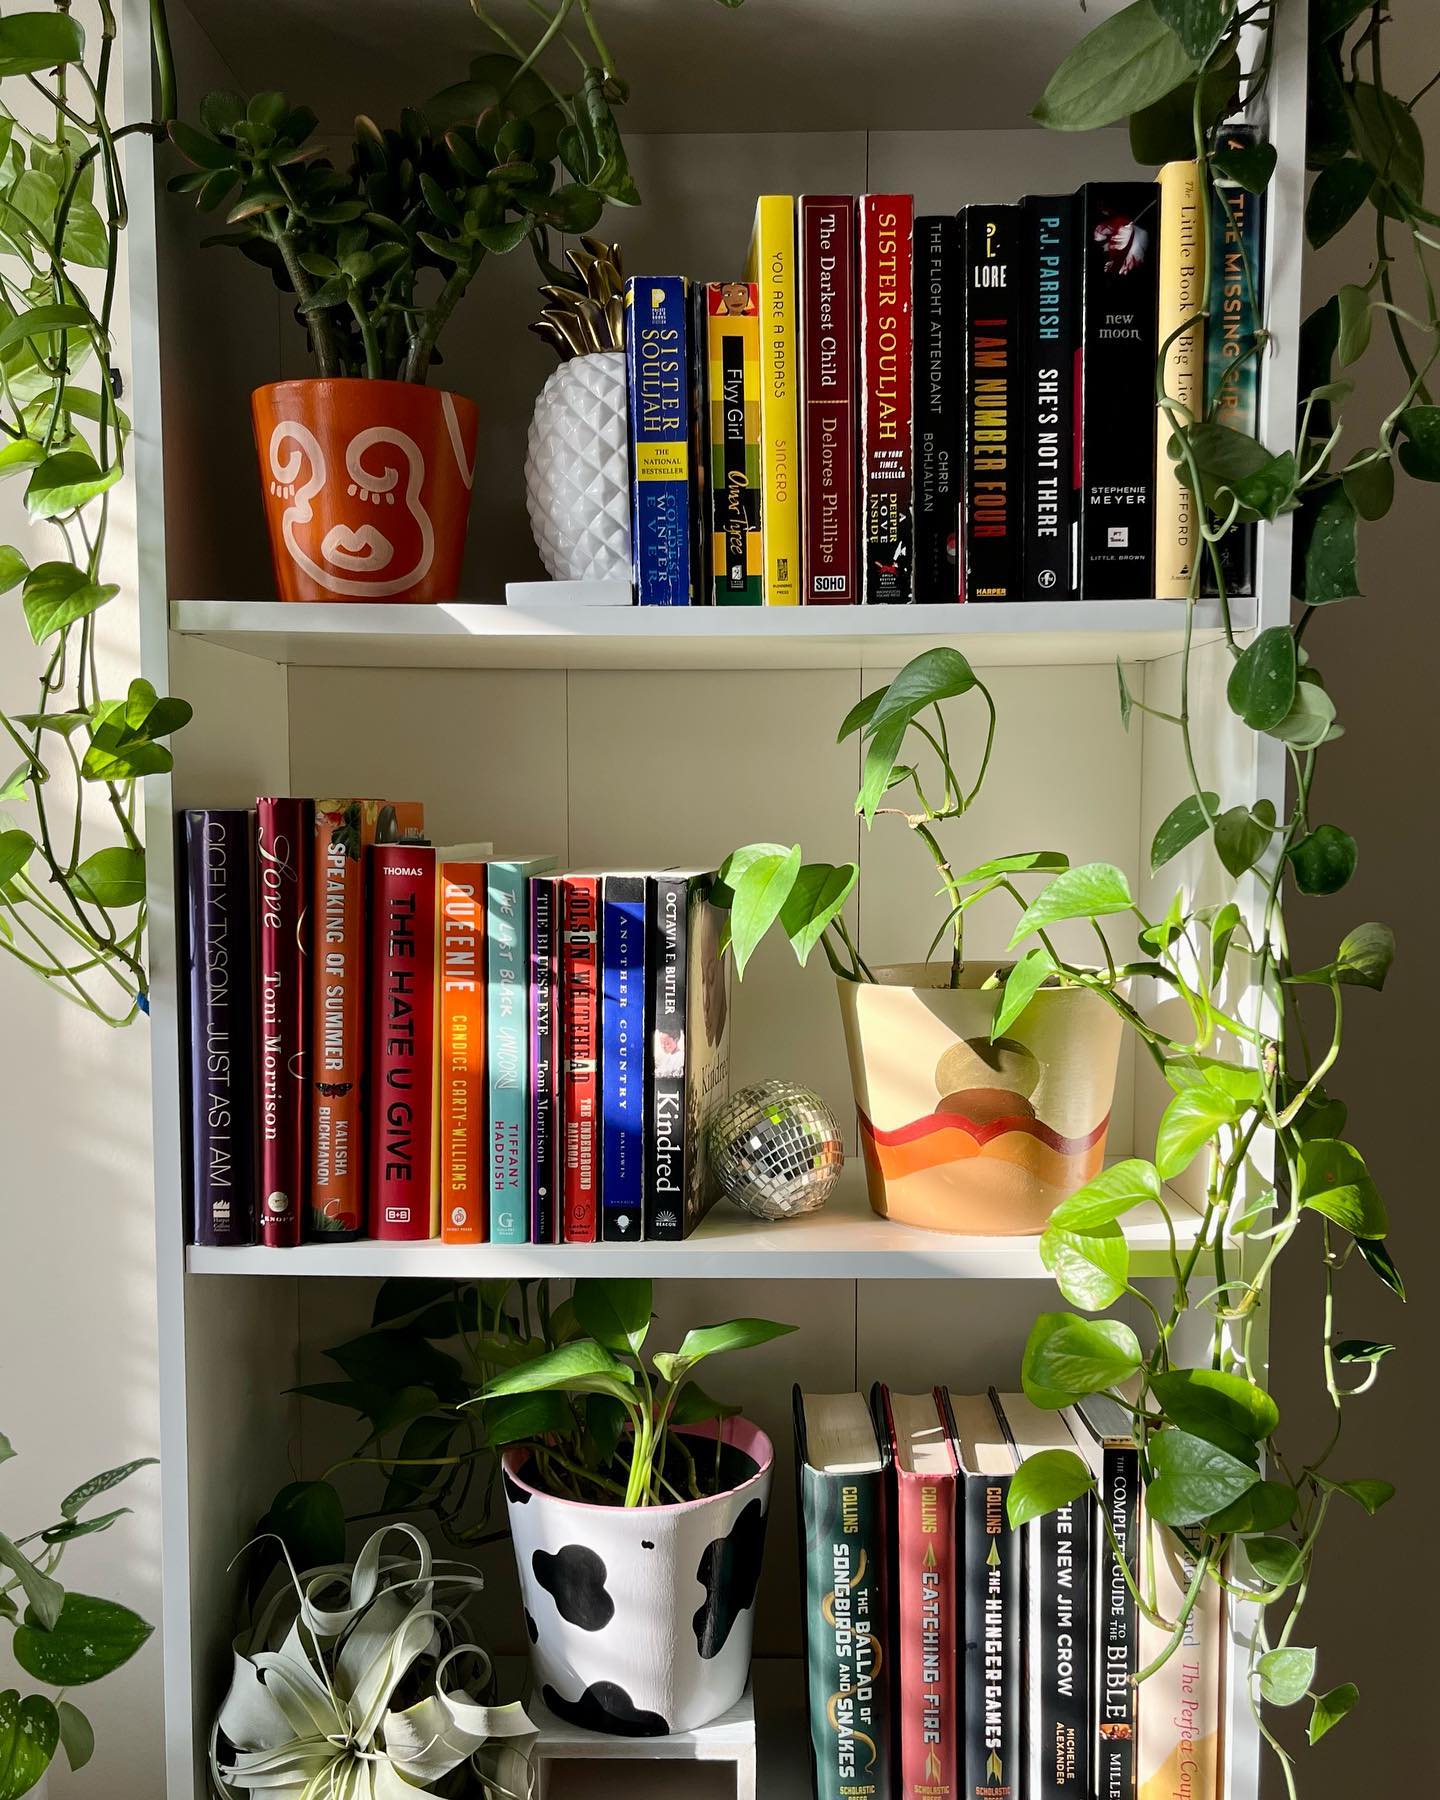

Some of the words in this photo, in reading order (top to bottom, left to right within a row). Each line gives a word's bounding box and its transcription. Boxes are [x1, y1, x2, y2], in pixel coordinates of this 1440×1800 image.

[1184, 181, 1194, 199] The
[819, 214, 835, 251] The
[930, 223, 942, 255] THE
[1039, 218, 1060, 251] P.J.
[1180, 206, 1196, 258] Little
[1223, 193, 1246, 245] THE
[771, 252, 785, 286] YOU
[878, 213, 897, 307] SISTER
[974, 265, 1007, 288] LORE
[772, 291, 785, 318] ARE
[820, 256, 836, 330] Darkest
[930, 259, 942, 316] FLIGHT
[1039, 256, 1060, 341] PARRISH
[1179, 266, 1196, 312] Book
[1222, 252, 1243, 358] MISSING
[772, 325, 785, 334] A
[1098, 328, 1143, 343] moon
[1103, 314, 1135, 325] new
[772, 341, 786, 399] BADASS
[820, 336, 837, 388] Child
[930, 321, 942, 414] ATTENDANT
[974, 337, 1008, 368] AM
[1172, 336, 1194, 365] Big
[640, 329, 661, 433] SOULJAH
[660, 329, 680, 431] SISTER
[725, 369, 744, 403] Flyy
[874, 317, 898, 440] SOULJAH
[1038, 369, 1059, 425] SHE'S
[1177, 373, 1193, 408] Lie
[727, 416, 744, 440] Girl
[974, 379, 1008, 471] NUMBER
[1037, 432, 1059, 469] NOT
[641, 467, 684, 475] BESTSELLER
[775, 439, 788, 502] SINCERO
[820, 417, 838, 487] Delores
[870, 471, 906, 480] BESTSELLER
[874, 450, 886, 459] NEW
[887, 450, 904, 459] YORK
[879, 461, 898, 469] TIMES
[923, 432, 934, 512] BOHJALIAN
[938, 450, 949, 493] CHRIS
[728, 470, 749, 515] Omar
[974, 482, 1007, 537] FOUR
[1037, 477, 1058, 537] THERE
[1090, 495, 1146, 505] MEYER
[1091, 486, 1146, 494] STEPHENIE
[647, 496, 658, 583] EVER
[656, 495, 668, 582] WINTER
[666, 495, 678, 582] COLDEST
[723, 505, 757, 555] Tyree
[819, 493, 838, 563] Phillips
[870, 493, 879, 544] INSIDE
[880, 493, 888, 544] LOVE
[889, 493, 898, 543] DEEPER
[899, 512, 907, 523] A
[1177, 486, 1190, 547] IFFORD
[815, 577, 844, 591] SOHO
[976, 588, 1007, 596] HARPER
[205, 822, 226, 911] CICELY
[257, 826, 297, 929] Love
[383, 866, 423, 876] THOMAS
[325, 842, 346, 944] SPEAKING
[497, 889, 518, 916] THE
[536, 893, 548, 930] THE
[388, 893, 416, 958] THE
[444, 884, 475, 992] QUEENIE
[497, 923, 516, 960] LAST
[568, 886, 590, 960] COLSON
[664, 892, 678, 949] OCTAVIA
[206, 917, 228, 1007] TYSON
[325, 953, 345, 979] OF
[536, 934, 549, 998] BLUEST
[619, 915, 628, 1008] ANOTHER
[664, 953, 676, 963] E.
[263, 970, 282, 1024] Toni
[387, 970, 416, 1056] HATE
[498, 968, 516, 1017] BLACK
[664, 966, 677, 1015] BUTLER
[324, 985, 346, 1070] SUMMER
[450, 1014, 467, 1072] CANDICE
[536, 1002, 549, 1036] EYE
[568, 969, 590, 1084] WHITEHEAD
[206, 1023, 230, 1087] JUST
[386, 1067, 413, 1089] U
[494, 1027, 519, 1091] UNICORN
[536, 1060, 549, 1094] Toni
[618, 1019, 628, 1111] COUNTRY
[207, 1092, 230, 1127] AS
[262, 1034, 282, 1140] Morrison
[580, 1097, 592, 1118] THE
[316, 1106, 331, 1186] BUCKHANON
[333, 1119, 348, 1177] KALISHA
[385, 1101, 414, 1181] GIVE
[451, 1079, 467, 1191] CARTY-WILLIAMS
[494, 1121, 505, 1191] HADDISH
[507, 1124, 519, 1188] TIFFANY
[536, 1099, 548, 1164] Morrison
[567, 1121, 579, 1169] RAILROAD
[579, 1121, 592, 1191] UNDERGROUND
[655, 1090, 681, 1193] Kindred
[208, 1147, 232, 1187] AM
[1116, 1456, 1124, 1473] THE
[842, 1486, 859, 1534] COLLINS
[920, 1486, 938, 1534] COLLINS
[985, 1487, 1002, 1534] COLLINS
[1056, 1501, 1073, 1534] HE
[1111, 1476, 1128, 1562] COMPLETE
[988, 1569, 1001, 1594] THE
[1056, 1540, 1073, 1588] NEW
[832, 1543, 852, 1657] SONGBIRDS
[856, 1588, 869, 1614] THE
[1055, 1594, 1073, 1629] JIM
[1110, 1564, 1126, 1616] GUIDE
[921, 1571, 940, 1684] CATCHING
[984, 1598, 1003, 1680] HUNGER
[1109, 1620, 1118, 1641] THE
[1117, 1623, 1126, 1638] TO
[838, 1663, 851, 1692] AND
[855, 1621, 873, 1701] BALLAD
[1056, 1634, 1073, 1697] CROW
[1106, 1644, 1128, 1719] BIBLE
[1180, 1661, 1201, 1697] The
[837, 1698, 855, 1778] SNAKES
[859, 1707, 872, 1725] OF
[921, 1694, 940, 1745] FIRE
[984, 1684, 1003, 1749] GAMES
[1172, 1699, 1201, 1754] Perfect
[1055, 1721, 1065, 1785] ALEXANDER
[1066, 1728, 1075, 1779] MICHELLE
[1109, 1753, 1122, 1800] MILLE
[839, 1785, 876, 1794] SCHOLASTIC
[913, 1784, 950, 1794] SCHOLASTIC
[975, 1786, 1011, 1796] SCHOLASTIC
